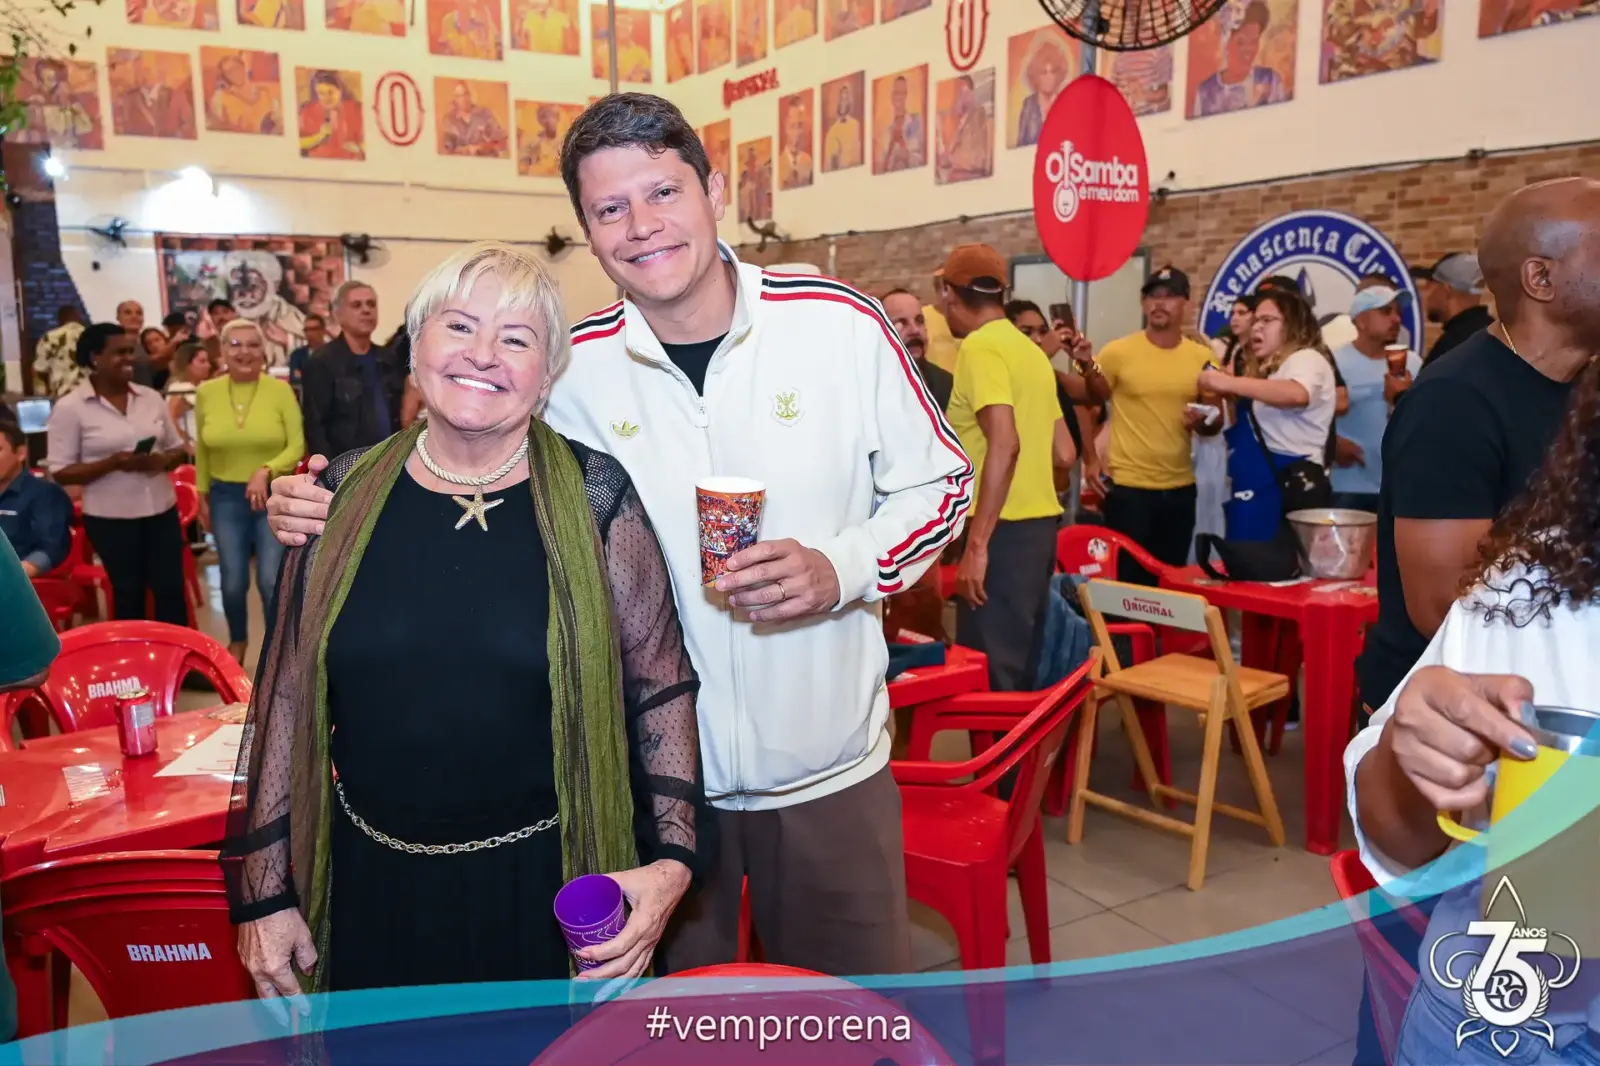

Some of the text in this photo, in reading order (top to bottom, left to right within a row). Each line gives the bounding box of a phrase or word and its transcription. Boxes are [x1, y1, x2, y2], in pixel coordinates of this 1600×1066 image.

[1070, 152, 1138, 186] Samba
[1088, 187, 1112, 201] meu
[1113, 184, 1140, 202] dom
[1209, 226, 1341, 319] Renascença
[1122, 598, 1175, 618] ORIGINAL
[88, 676, 142, 699] BRAHMA
[126, 942, 212, 961] BRAHMA
